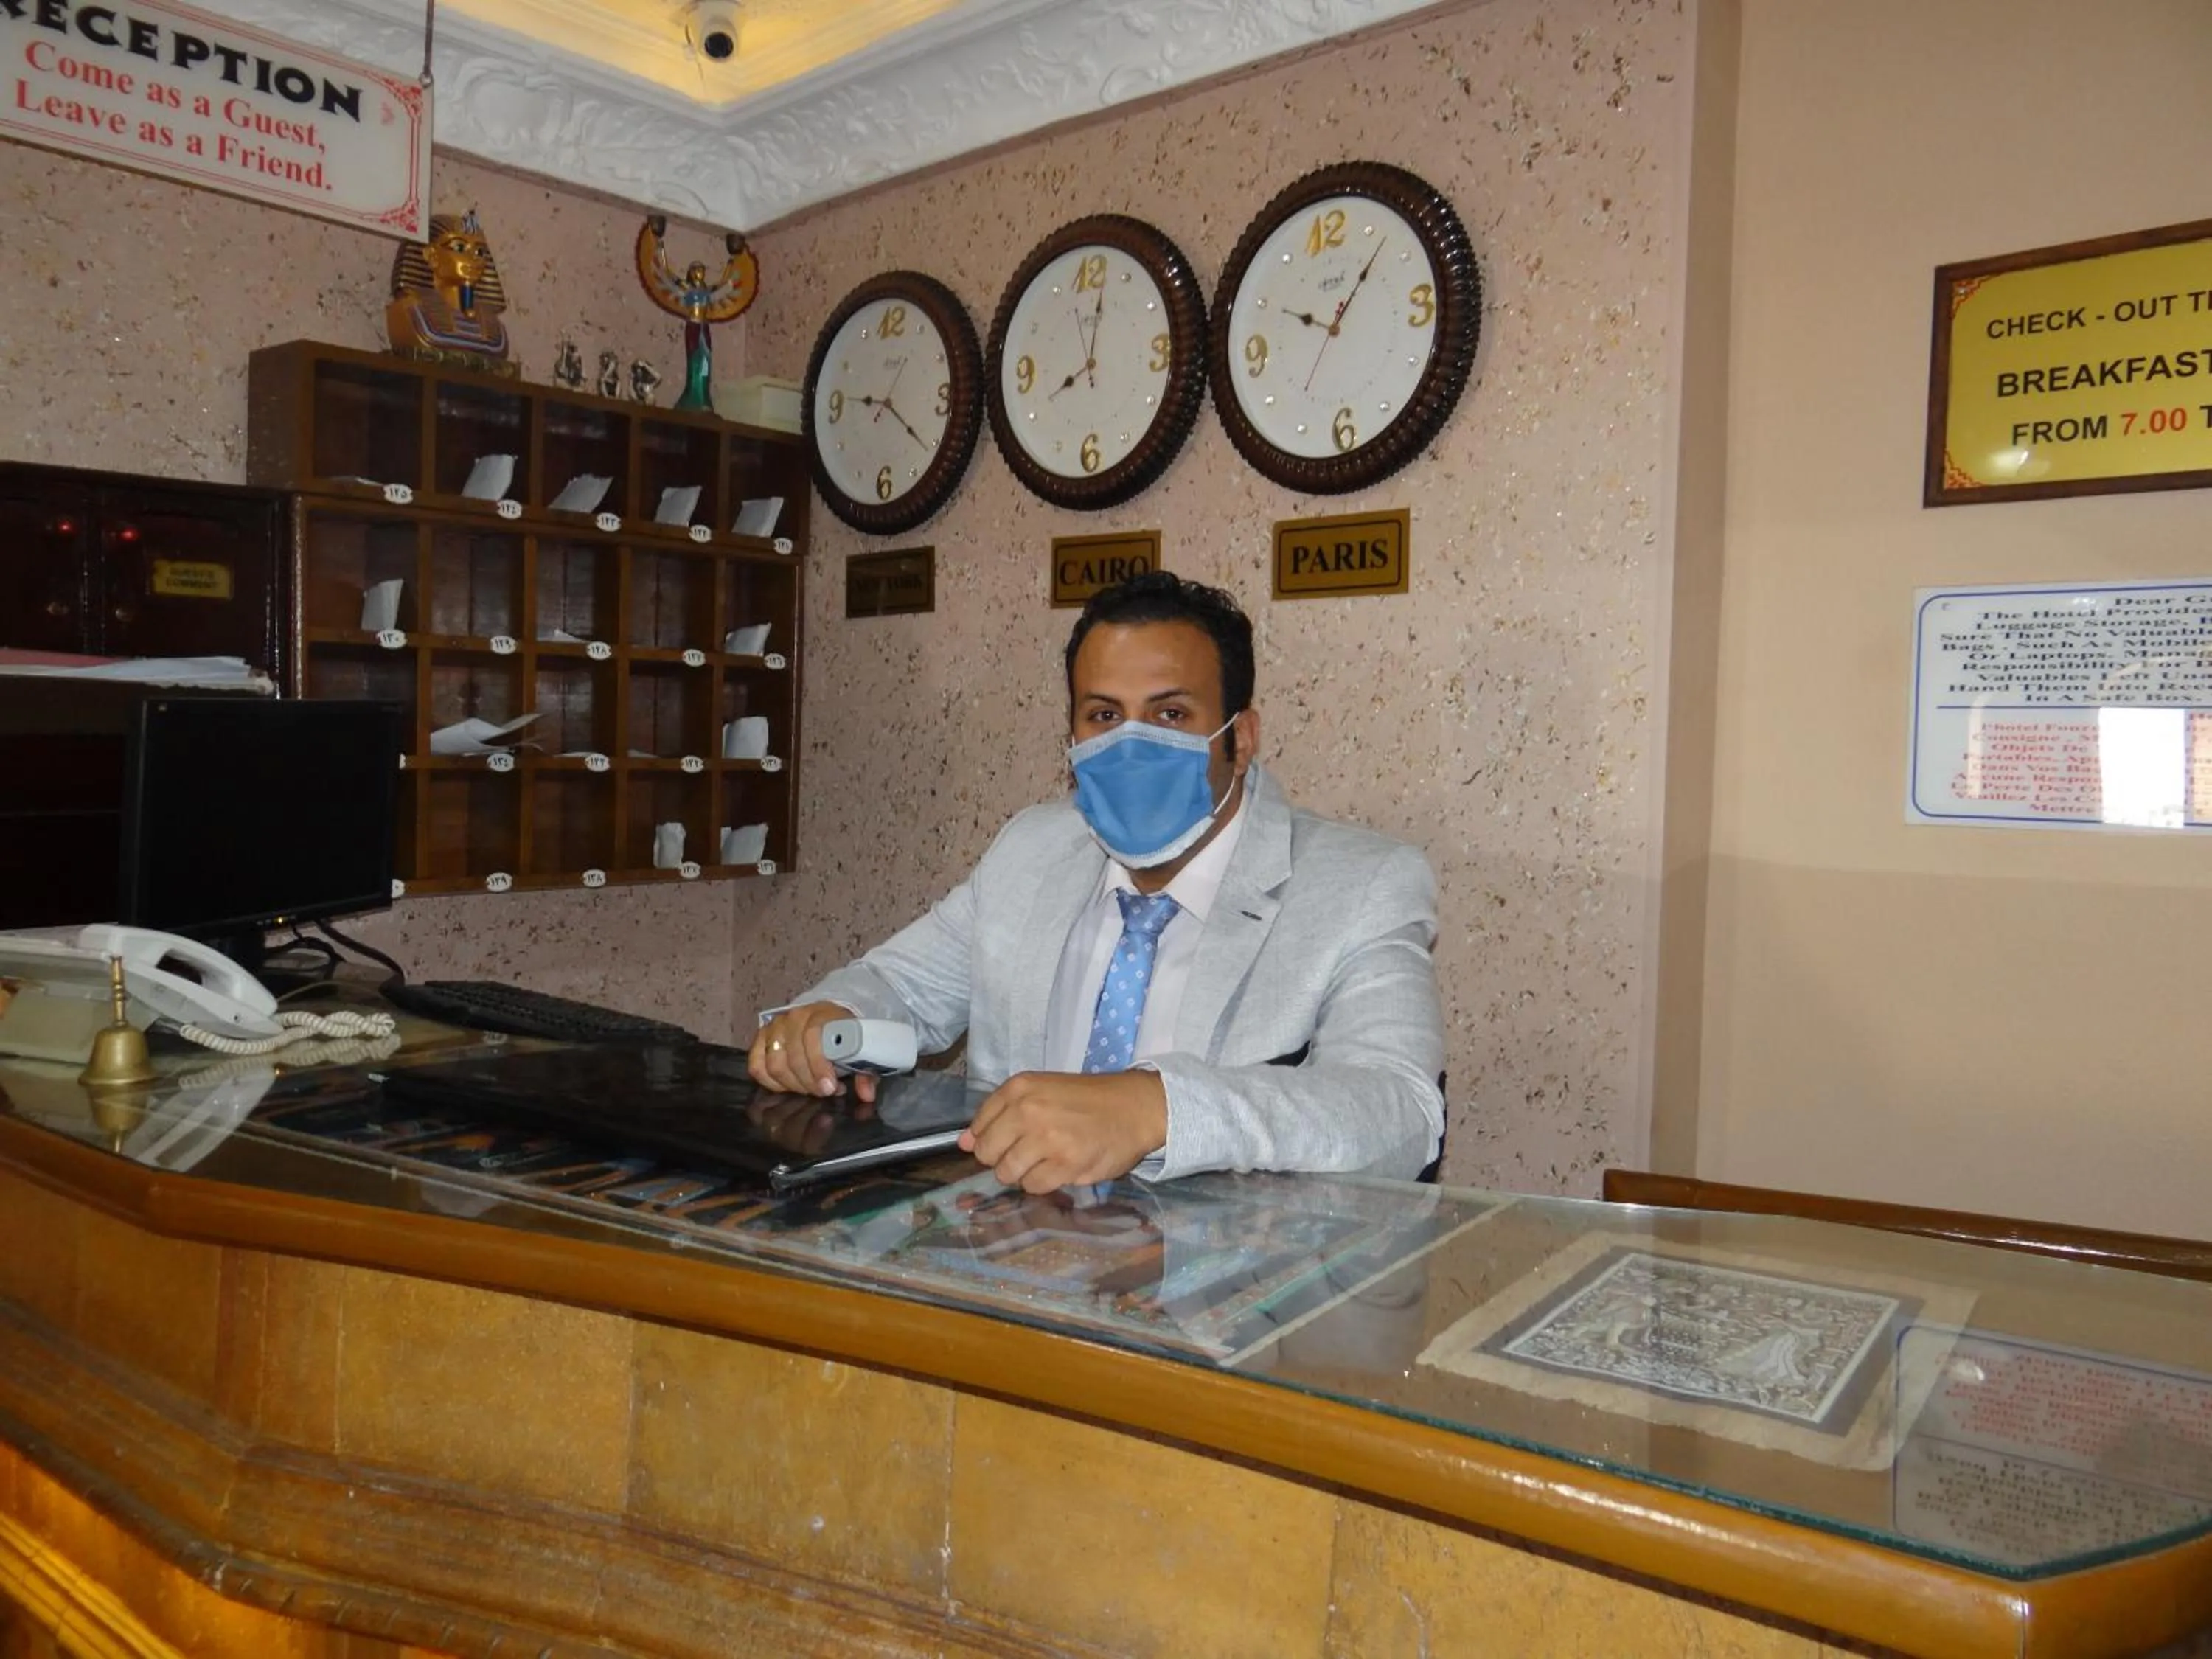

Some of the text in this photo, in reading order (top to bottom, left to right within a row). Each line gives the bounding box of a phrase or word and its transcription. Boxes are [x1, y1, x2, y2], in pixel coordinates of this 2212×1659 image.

[25, 40, 327, 154] Come as a Guest,
[15, 78, 333, 191] Leave as a Friend.
[1304, 209, 1346, 258] 12
[1072, 254, 1109, 293] 12
[877, 305, 907, 340] 12
[1408, 282, 1435, 328] 3
[1986, 307, 2087, 340] CHECK
[2114, 294, 2178, 323] OUT
[1148, 333, 1171, 372] 3
[1245, 334, 1268, 378] 9
[1016, 355, 1035, 394] 9
[1997, 348, 2212, 399] BREAKFAST
[828, 389, 845, 425] 9
[2011, 414, 2108, 446] FROM
[2120, 407, 2188, 437] 7.00
[1332, 407, 1356, 453] 6
[1080, 433, 1101, 474] 6
[875, 465, 893, 501] 6
[1060, 555, 1150, 585] CAIRO
[1291, 538, 1389, 575] PARIS
[1978, 611, 2023, 619] The
[2032, 609, 2096, 619] Hotel
[2115, 597, 2176, 606] Dear
[1940, 633, 1992, 641] Sure
[1998, 631, 2053, 639] That
[1976, 621, 2075, 630] Luggage
[1942, 643, 1994, 651] Bags
[2017, 641, 2074, 649] Such
[2081, 640, 2112, 648] As
[1948, 684, 2010, 692] Hand
[2019, 683, 2087, 691] Them
[1978, 673, 2090, 681] Valuables
